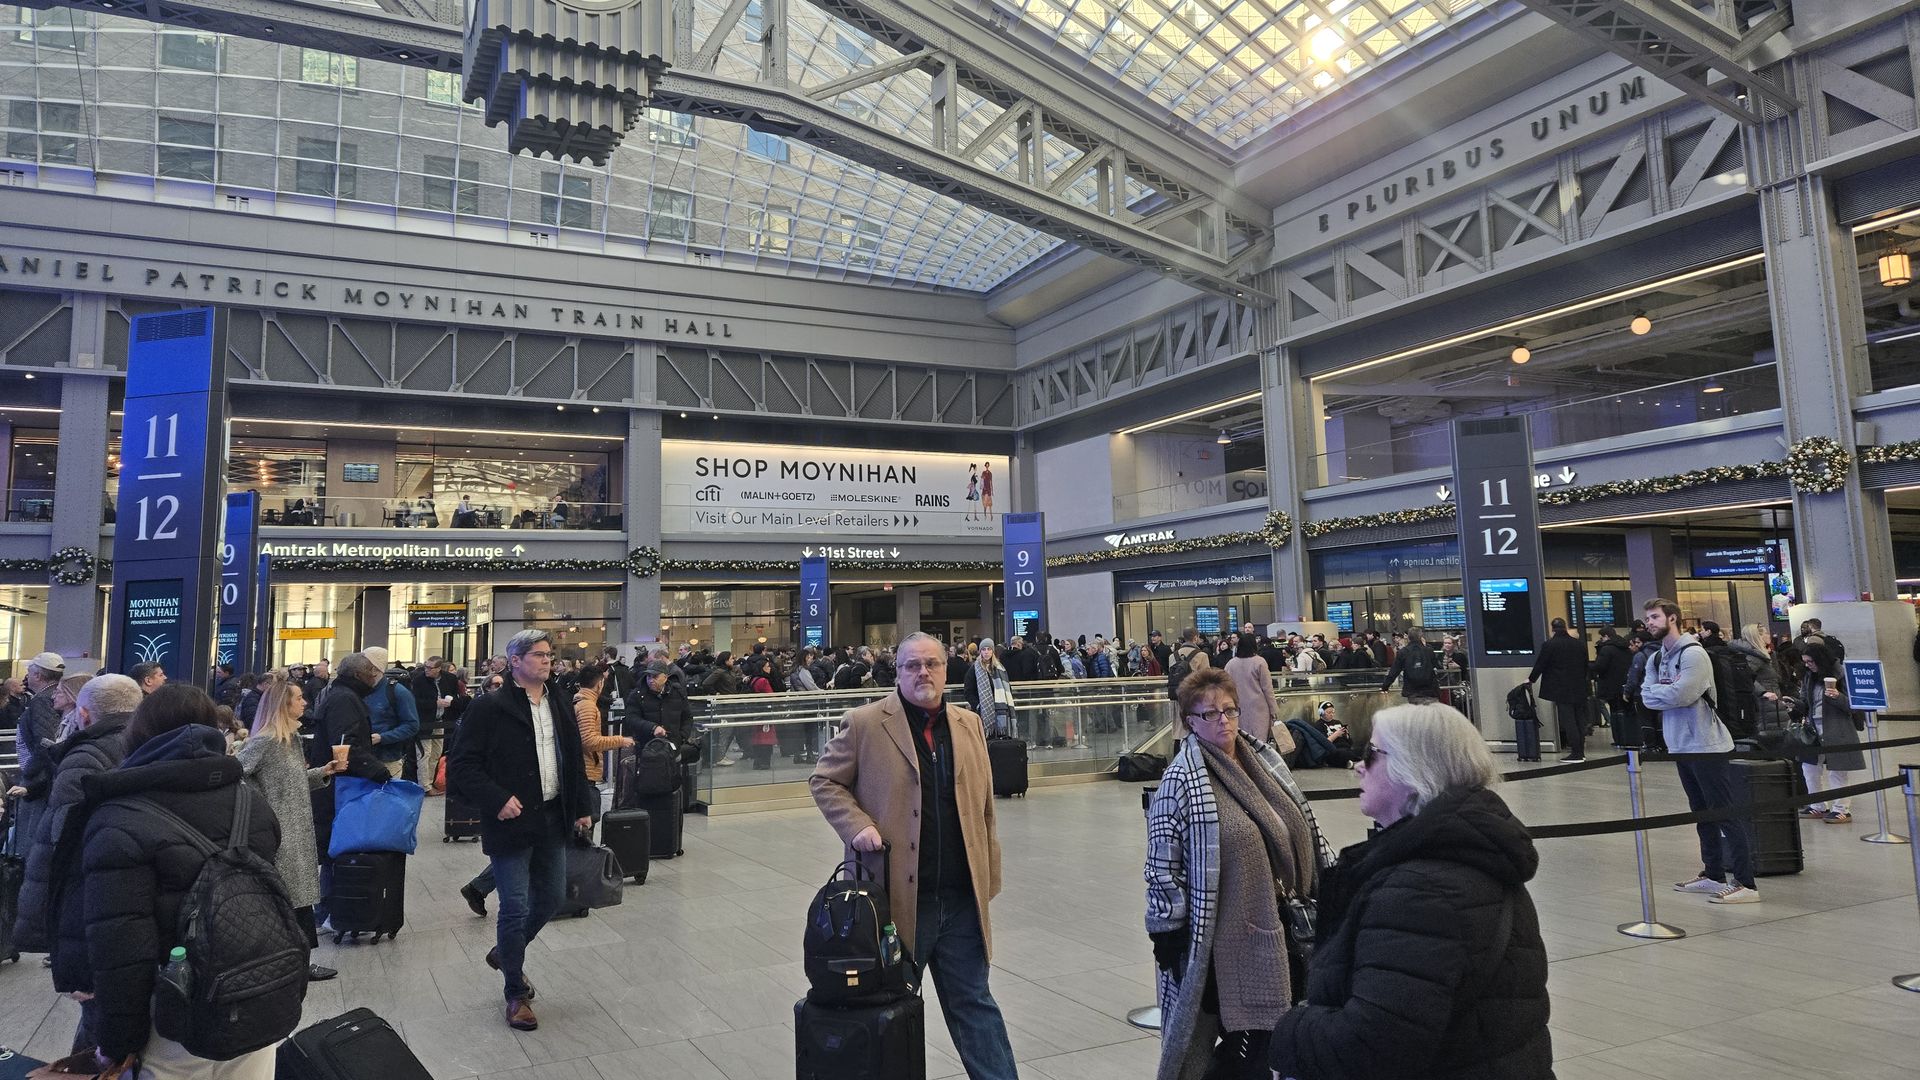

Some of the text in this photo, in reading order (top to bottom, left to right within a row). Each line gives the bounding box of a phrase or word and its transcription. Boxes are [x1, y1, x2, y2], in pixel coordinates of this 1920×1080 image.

[1318, 75, 1646, 232] E PLURIBUS UNUM
[146, 268, 317, 301] PATRICK
[345, 287, 529, 319] MOYNIHAN
[551, 307, 645, 329] TRAIN
[664, 318, 733, 338] HALL
[143, 413, 179, 459] 11
[695, 457, 917, 484] SHOP MOYNIHAN
[740, 491, 816, 502] (MALIN+GOETZ)
[837, 493, 898, 504] MOLESKINE
[915, 494, 950, 508] RAINS
[1479, 478, 1512, 507] 11
[134, 495, 180, 542] 12
[695, 511, 889, 528] Visit Our Main Level Retailers
[1122, 530, 1175, 547] AMTRAK
[1481, 527, 1518, 555] 12
[261, 542, 504, 561] Amtrak Metropolitan Lounge
[818, 546, 884, 559] 31st Street
[1017, 550, 1030, 568] 9
[809, 583, 818, 596] 7
[1015, 579, 1035, 597] 10
[1159, 574, 1254, 588] Amtrak Ticketing and Baggage Check-in
[129, 598, 179, 609] MOYNIHAN
[809, 603, 818, 616] 8
[129, 607, 180, 618] TRAIN HALL
[1852, 667, 1876, 676] Enter
[1855, 677, 1875, 685] here
